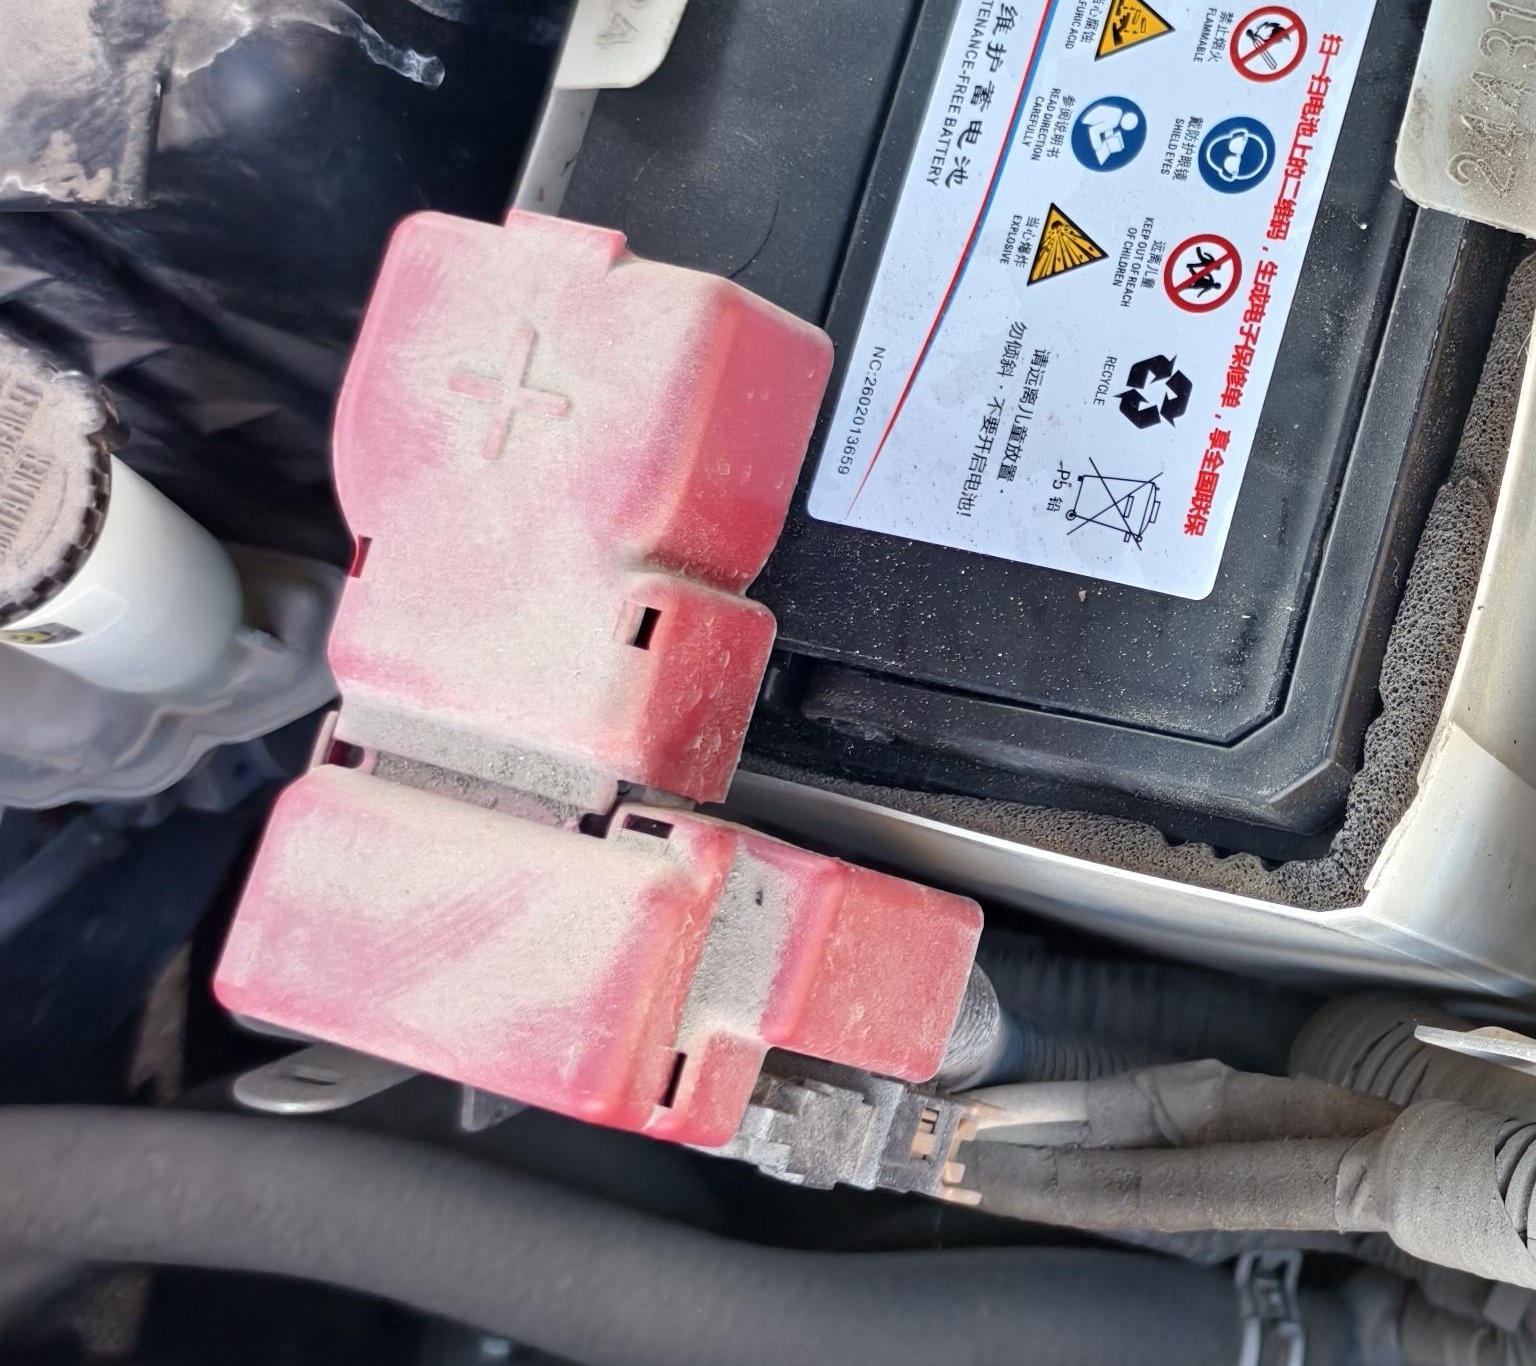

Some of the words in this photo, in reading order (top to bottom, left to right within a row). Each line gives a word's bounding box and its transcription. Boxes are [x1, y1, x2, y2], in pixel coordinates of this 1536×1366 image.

[1064, 27, 1079, 50] ACID
[1193, 7, 1218, 63] FLAMMABLE
[1207, 11, 1234, 62] 禁止烟火
[1021, 95, 1045, 148] CAREFULLY
[1046, 87, 1061, 112] READ
[1030, 112, 1054, 161] DIRECTION
[1046, 94, 1077, 159] 参阅说明书
[1167, 118, 1185, 151] SHIELD
[1172, 116, 1204, 182] 戴防护眼镜
[926, 117, 958, 186] BATTERY
[1160, 151, 1176, 175] EYES
[999, 214, 1023, 265] EXPLOSIVE
[1013, 216, 1040, 268] 当心爆炸
[1126, 227, 1138, 241] OF
[1133, 241, 1148, 262] OUT
[1140, 216, 1155, 241] KEEP
[1112, 240, 1134, 287] CHILDREN
[1130, 262, 1142, 276] OF
[1140, 239, 1167, 289] 远离儿童
[1120, 276, 1138, 308] REACH
[1093, 355, 1118, 406] RECYCLE
[837, 346, 887, 475] NC:2602013659
